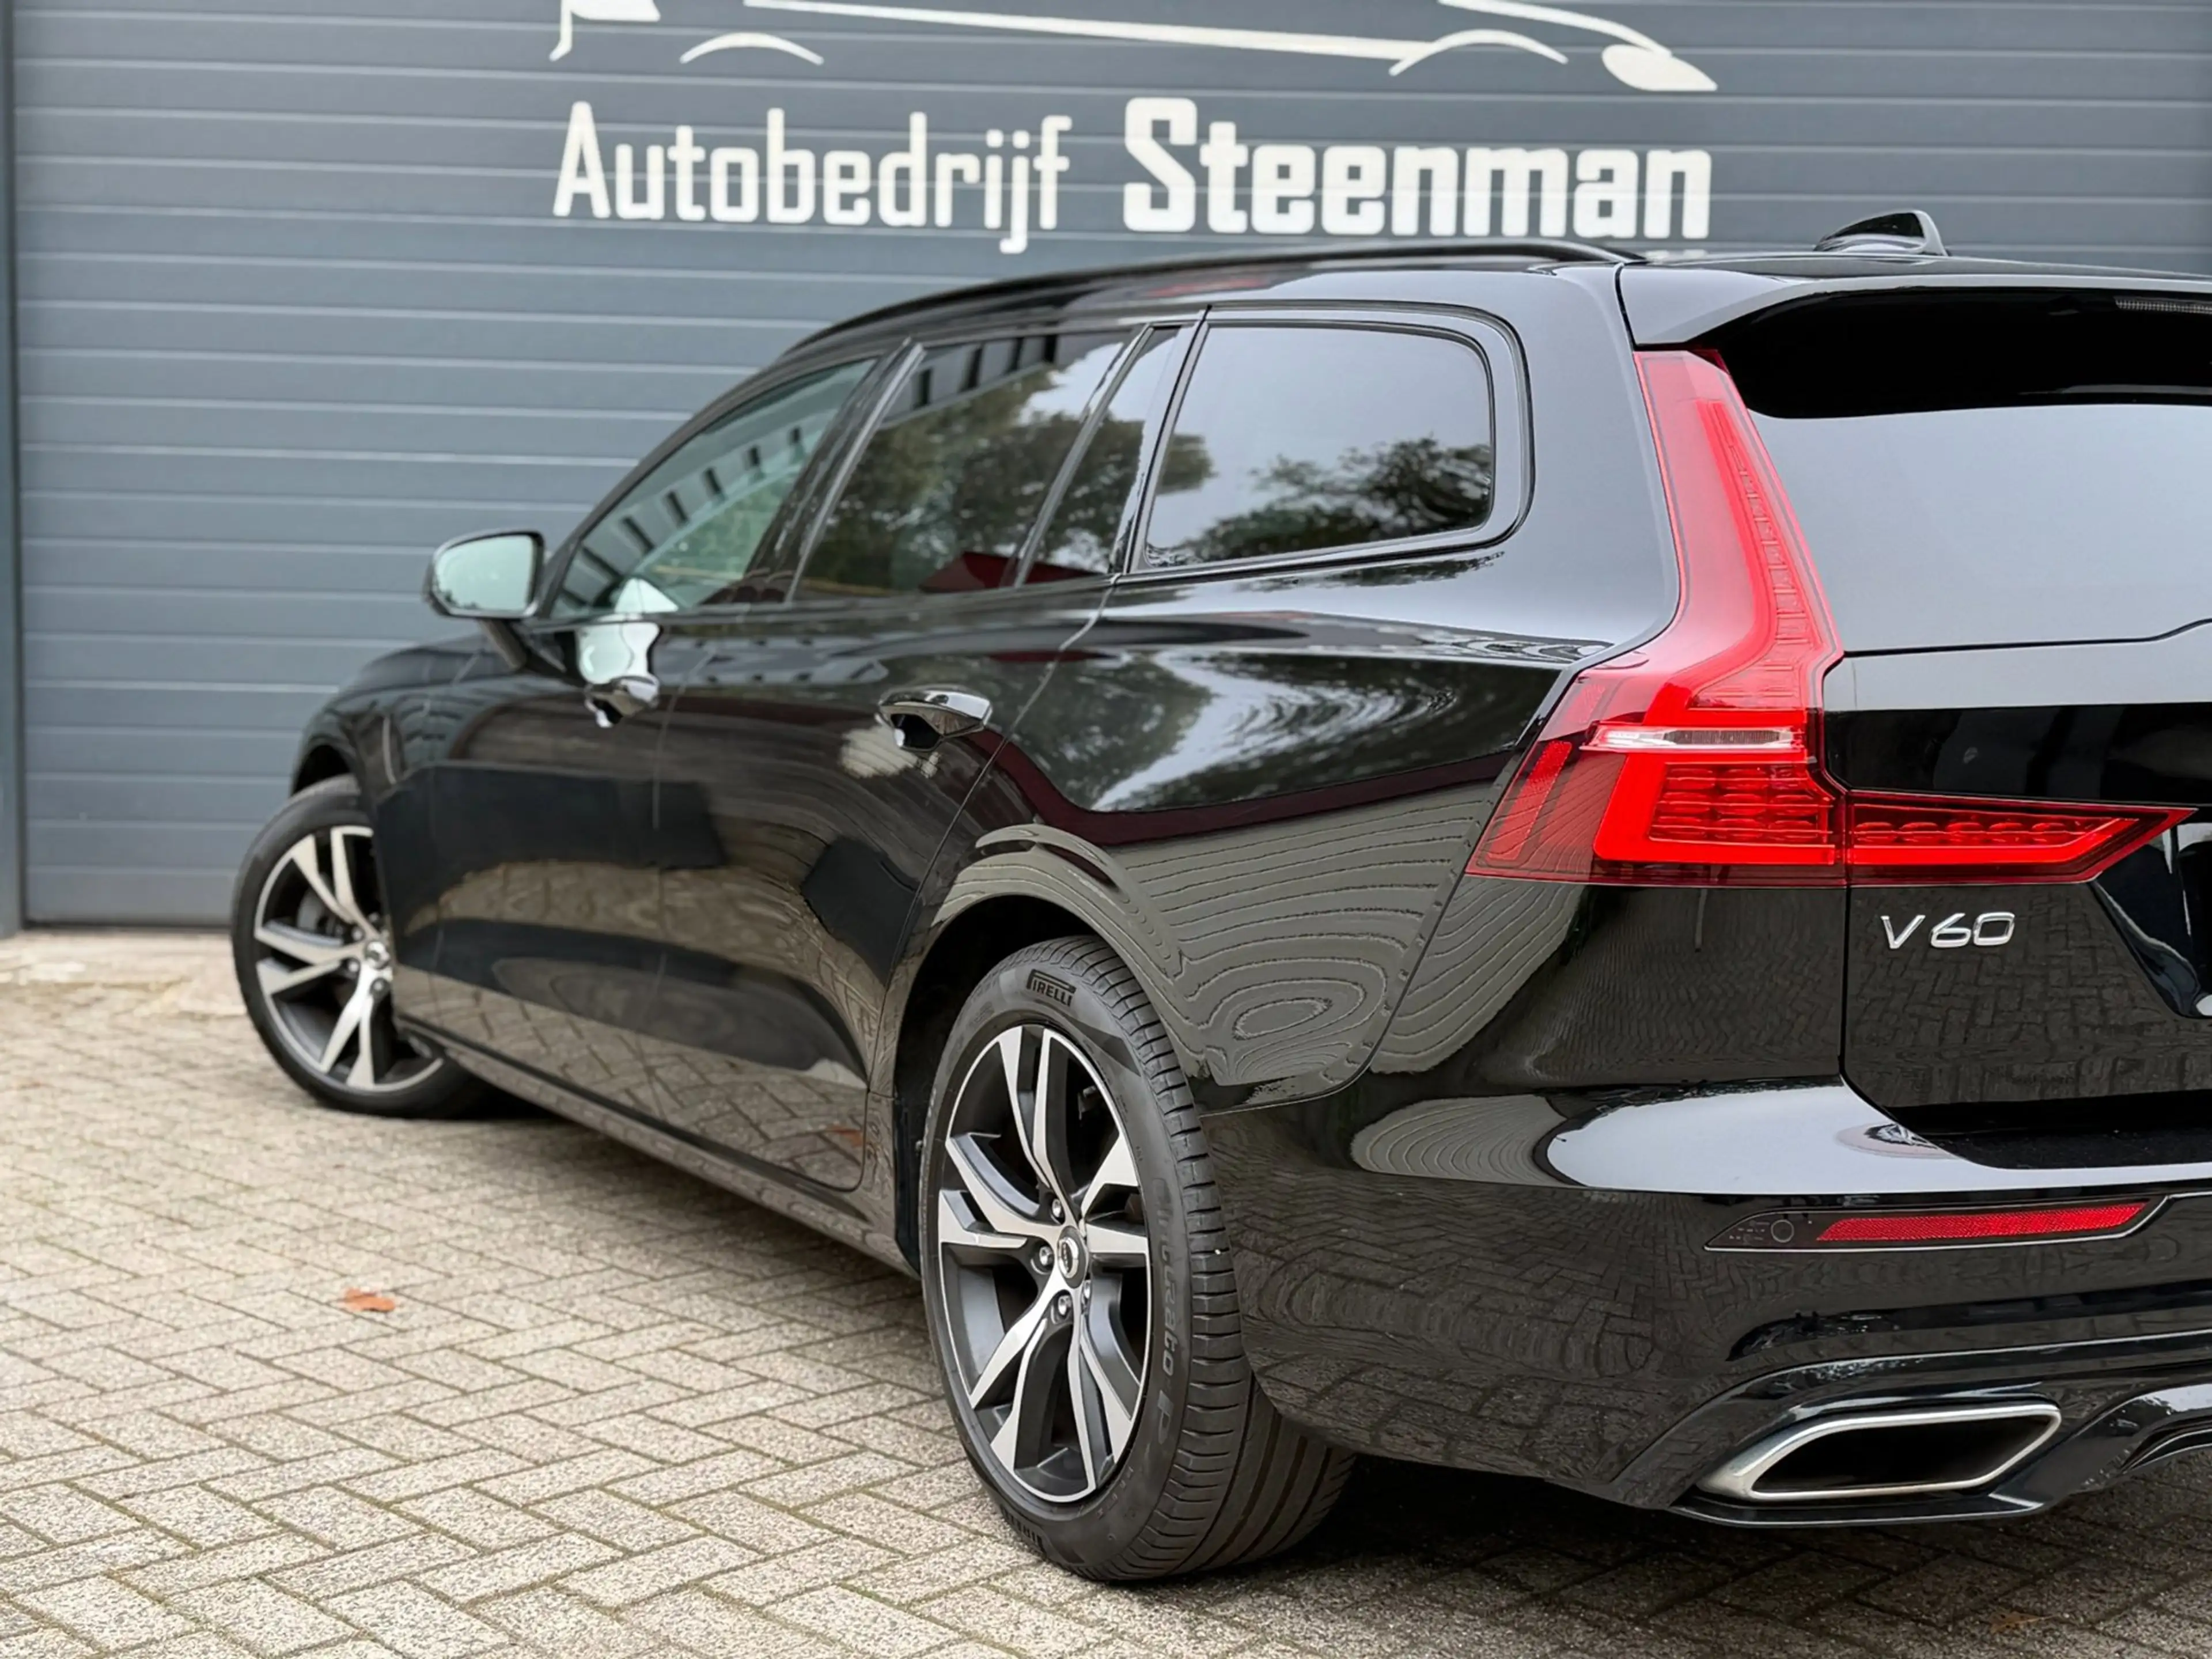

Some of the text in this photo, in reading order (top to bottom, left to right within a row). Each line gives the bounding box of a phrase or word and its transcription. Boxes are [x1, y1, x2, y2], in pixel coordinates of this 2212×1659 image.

[553, 97, 1712, 254] Autobedrijf Steenman
[1880, 911, 2016, 949] V60
[1026, 969, 1077, 1007] PIRELLI
